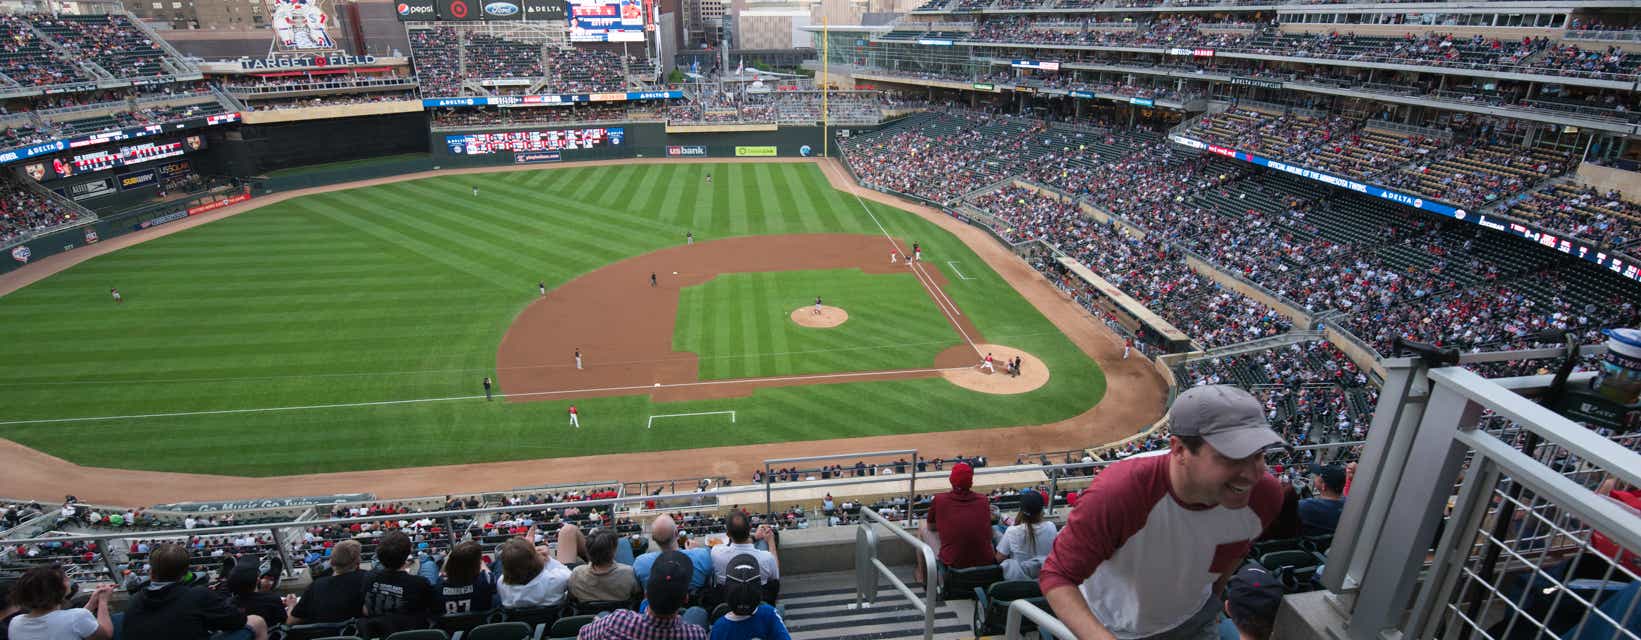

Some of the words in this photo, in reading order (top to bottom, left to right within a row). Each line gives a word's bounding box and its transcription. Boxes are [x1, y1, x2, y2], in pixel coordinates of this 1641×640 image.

[410, 5, 433, 14] pepsi
[491, 5, 512, 15] Ford
[241, 57, 312, 69] TARGET
[329, 55, 376, 66] FIELD
[33, 144, 55, 154] DELTA
[122, 173, 153, 187] SUBWAY
[1388, 193, 1412, 204] DELTA
[445, 598, 471, 616] 87
